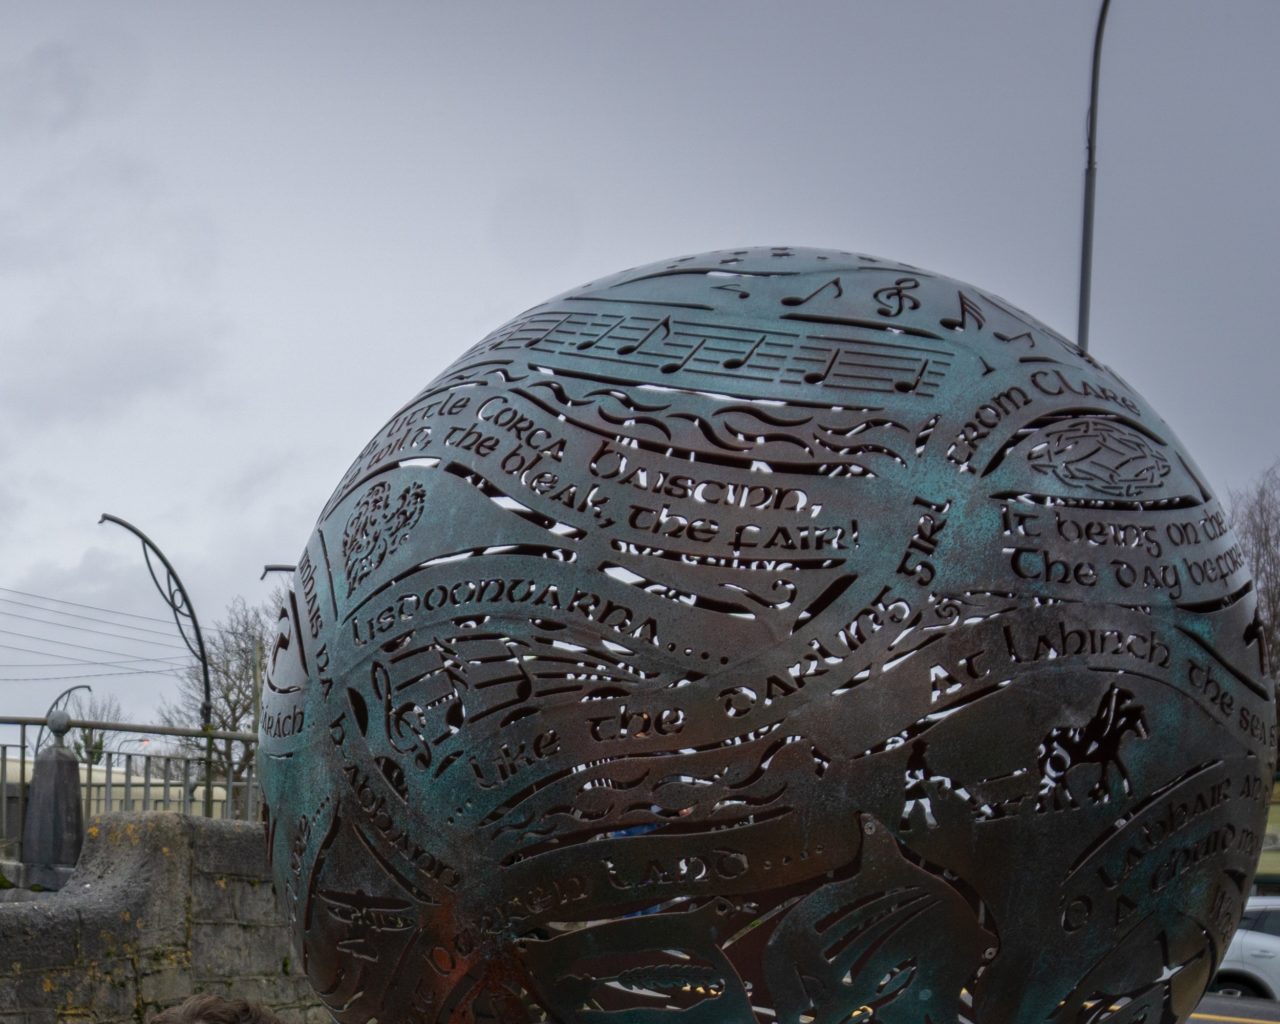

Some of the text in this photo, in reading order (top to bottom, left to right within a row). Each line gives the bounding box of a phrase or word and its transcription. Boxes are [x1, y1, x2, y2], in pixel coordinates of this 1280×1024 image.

[444, 423, 500, 457] the
[628, 504, 719, 542] the
[585, 704, 687, 742] the
